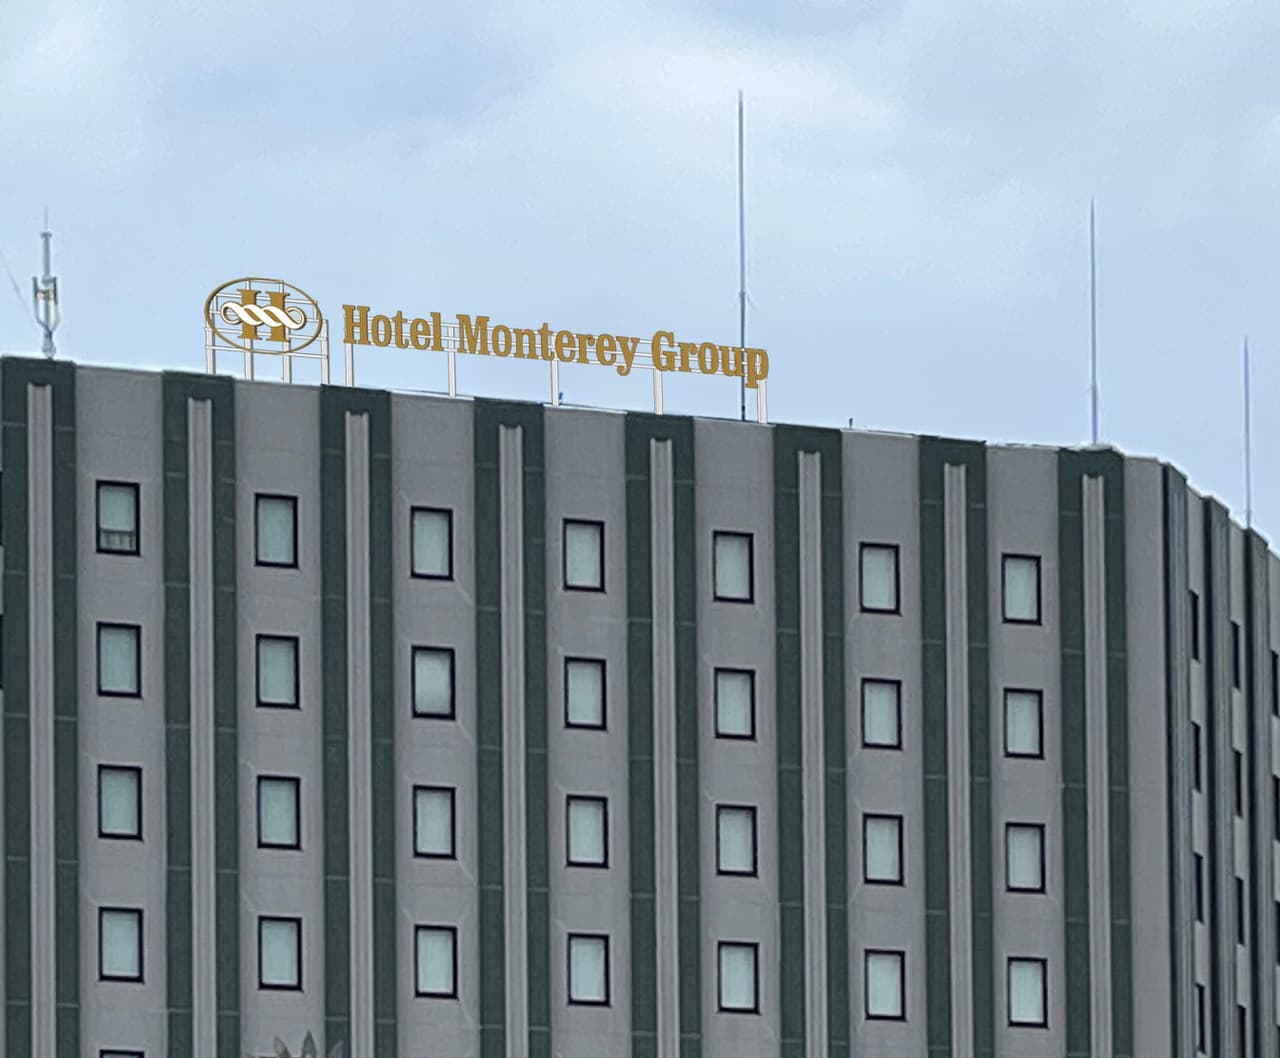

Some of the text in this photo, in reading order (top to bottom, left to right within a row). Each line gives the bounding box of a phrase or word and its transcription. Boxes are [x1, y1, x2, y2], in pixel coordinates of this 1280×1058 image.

[341, 303, 770, 389] Hotel Monterey Group
